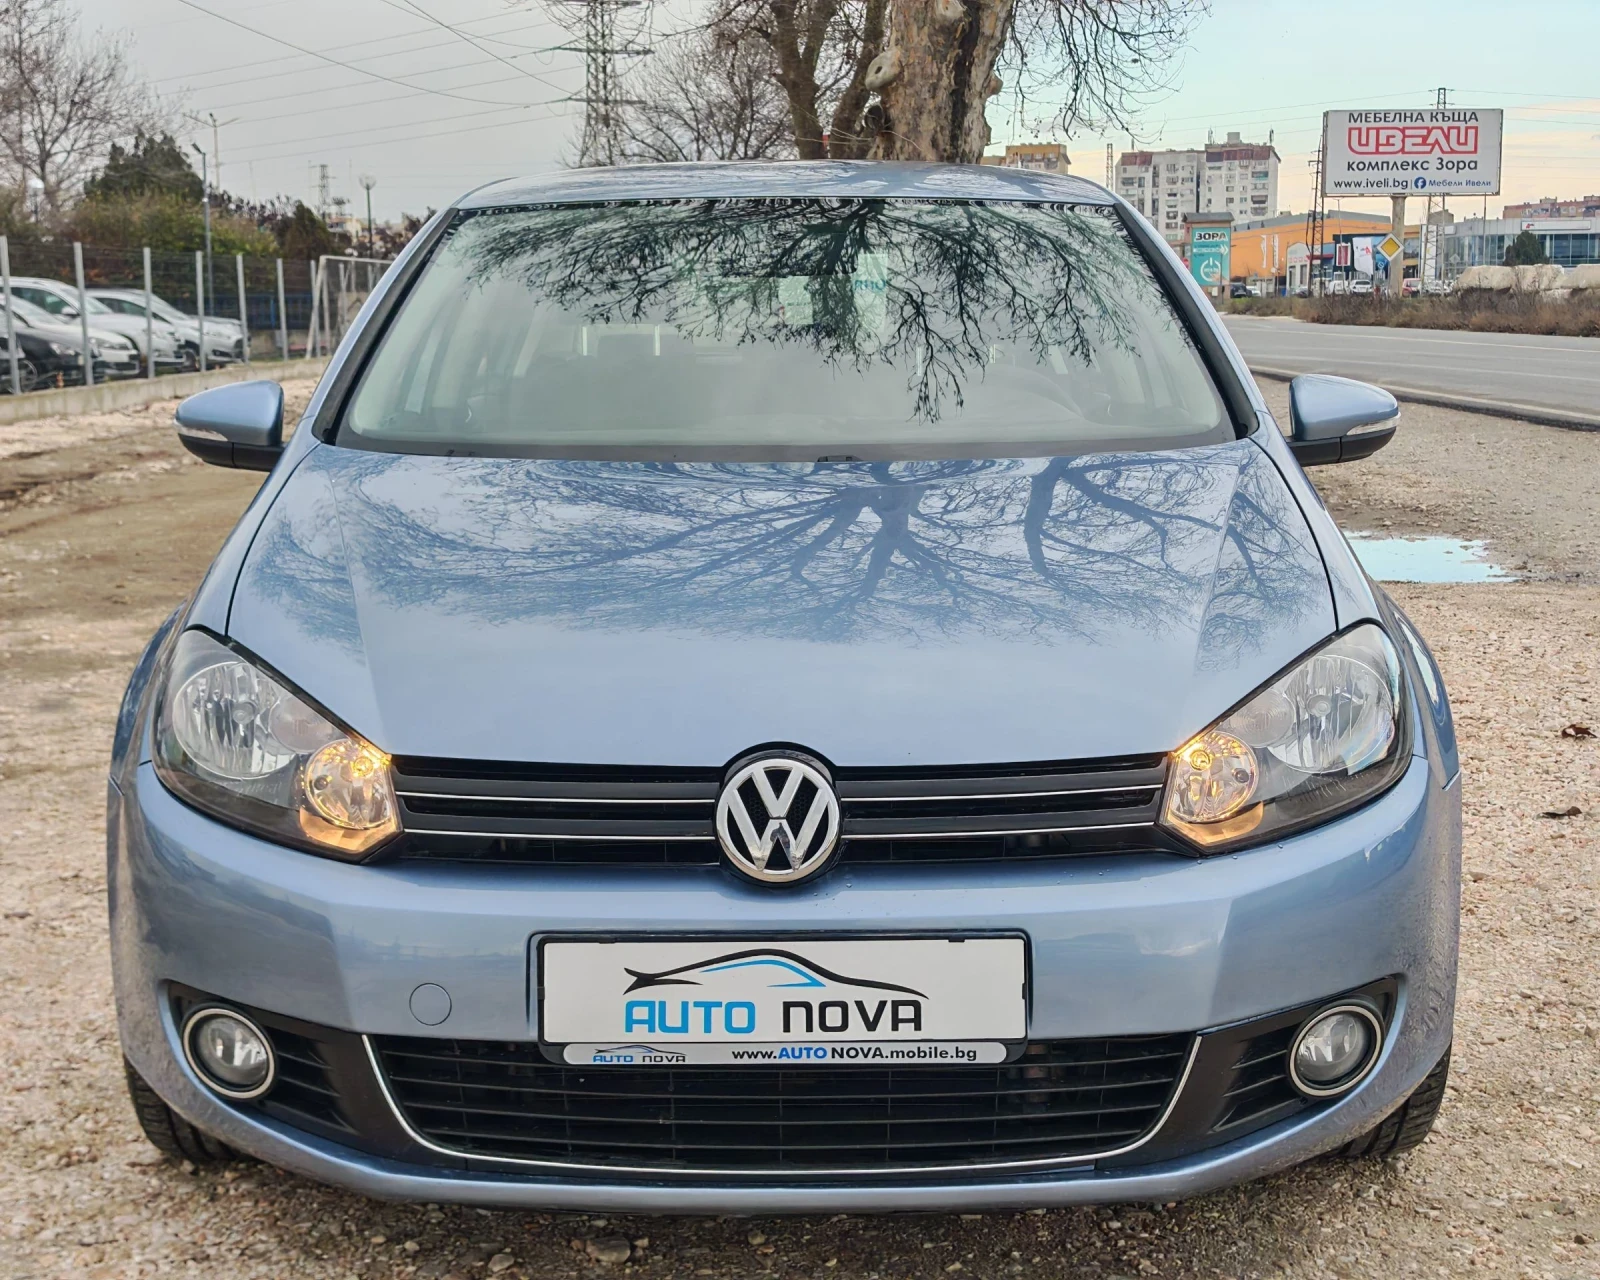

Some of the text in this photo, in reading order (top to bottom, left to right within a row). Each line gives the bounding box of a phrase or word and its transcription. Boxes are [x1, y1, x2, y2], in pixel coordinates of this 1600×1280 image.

[1348, 111, 1479, 125] МЕБЕЛНА КЪЩА
[1347, 157, 1478, 173] комплекс Зора
[1333, 178, 1409, 190] www.iveli.bg
[1428, 179, 1492, 187] Мебели Ивели
[1195, 231, 1228, 241] ЗОРА
[624, 999, 922, 1034] AUTO NOVA
[593, 1055, 686, 1063] AUTO NOVA
